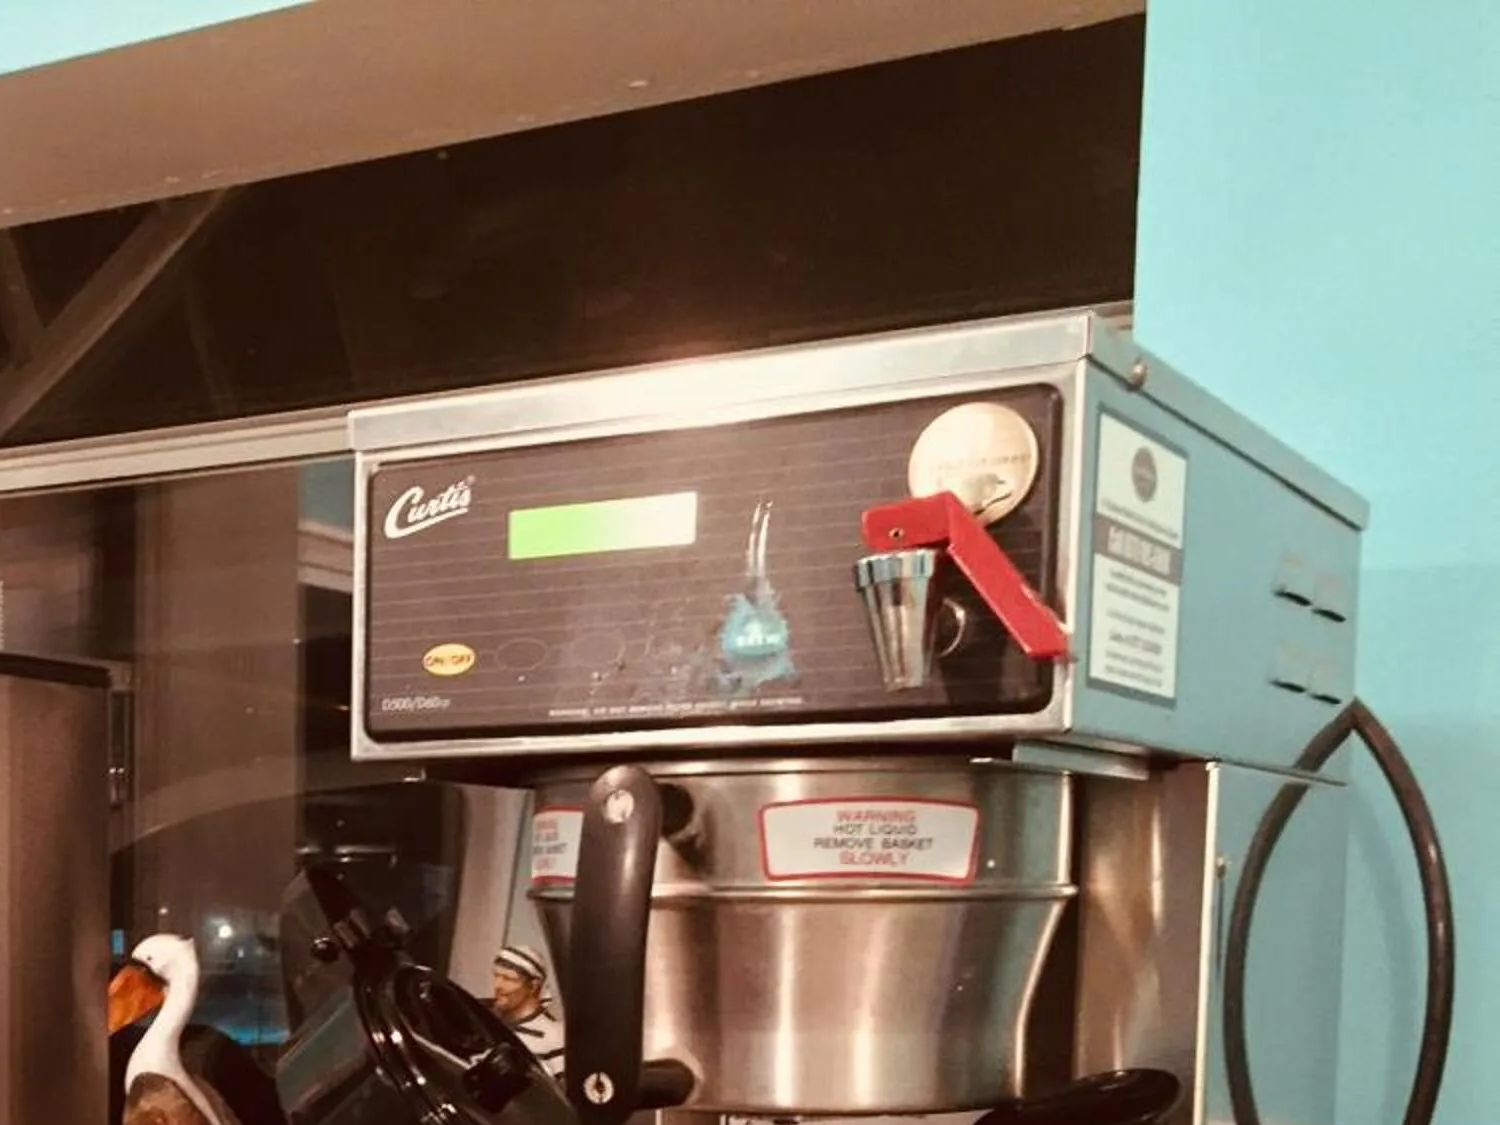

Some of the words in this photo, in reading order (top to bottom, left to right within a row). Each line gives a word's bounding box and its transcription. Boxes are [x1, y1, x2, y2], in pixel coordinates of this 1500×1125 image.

[384, 480, 472, 539] Curtis
[833, 824, 865, 836] HOT
[869, 824, 917, 836] LIQUID
[813, 837, 875, 850] REMOVE
[880, 837, 934, 850] BASKET
[839, 851, 911, 865] SLOWLY
